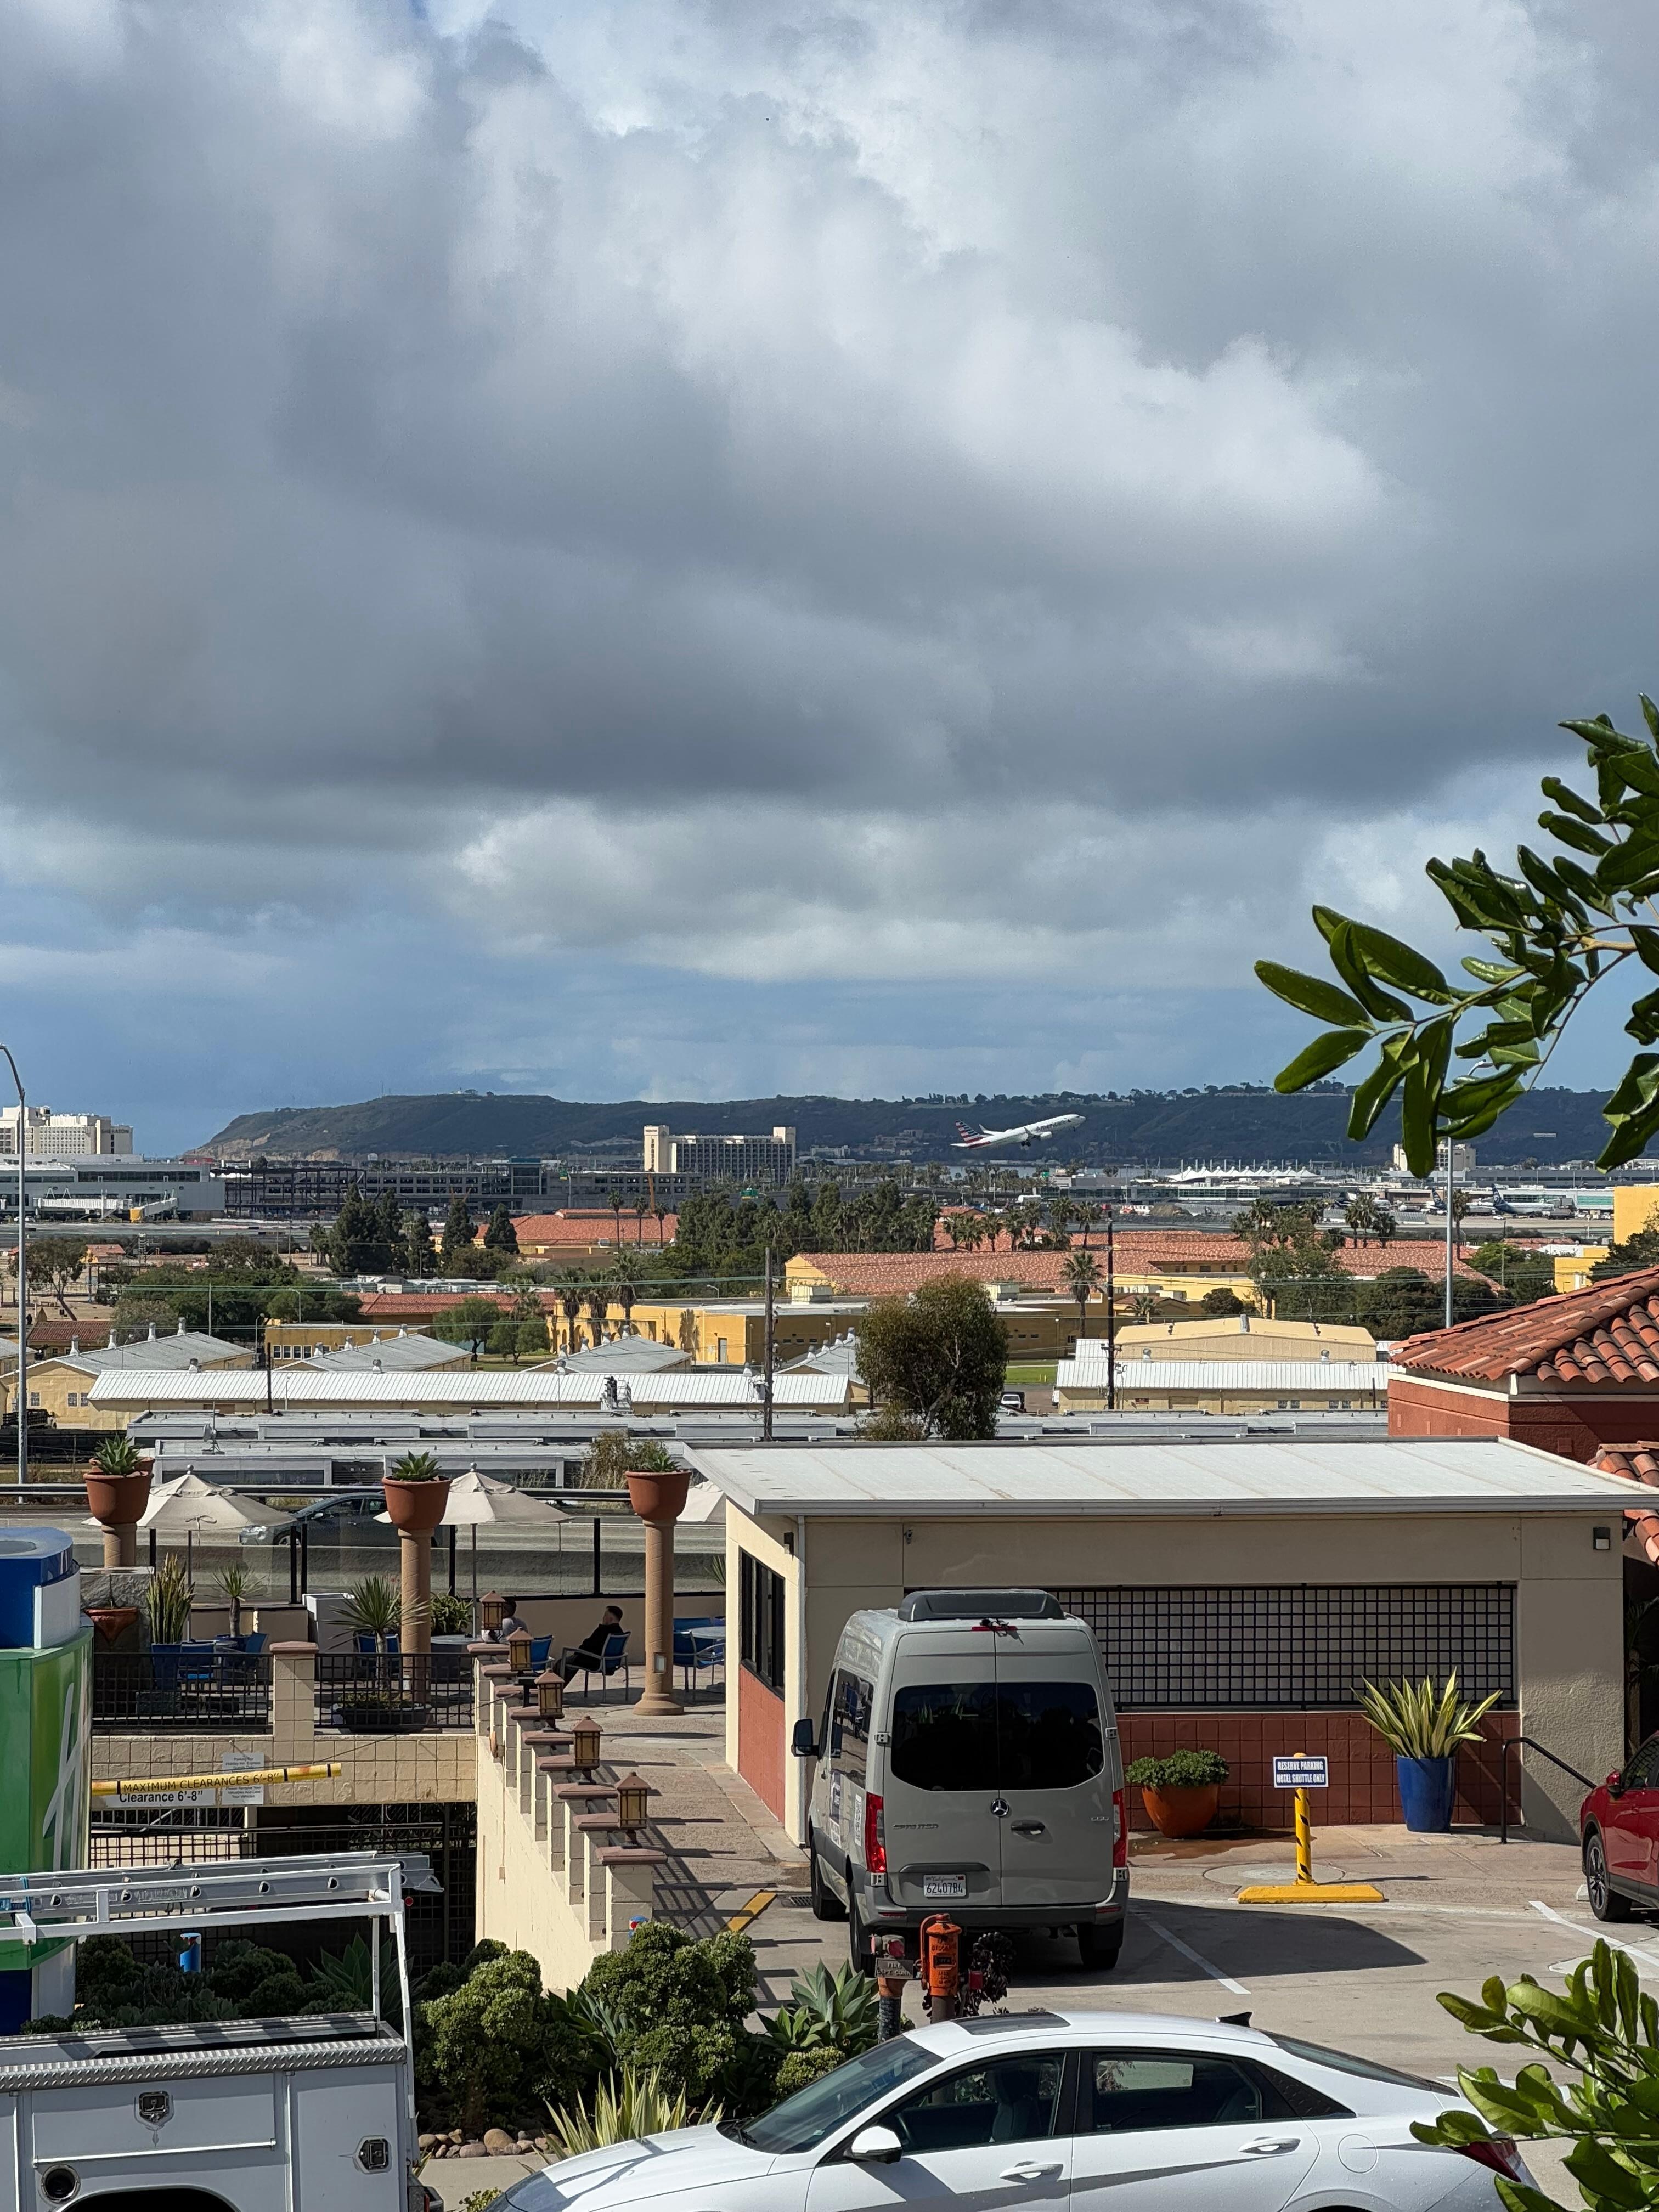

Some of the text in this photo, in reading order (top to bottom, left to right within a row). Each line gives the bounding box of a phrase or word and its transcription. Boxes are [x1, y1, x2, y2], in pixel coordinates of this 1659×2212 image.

[1036, 1120, 1066, 1132] American
[1277, 1760, 1323, 1771] RESERVE PARKING
[123, 1781, 176, 1793] MAXIMUM
[179, 1775, 250, 1790] CLEARANCES
[1277, 1773, 1325, 1784] HOTEL SHUTTLE ONLY
[119, 1793, 174, 1803] Clearance
[926, 1882, 963, 1894] 62407B4
